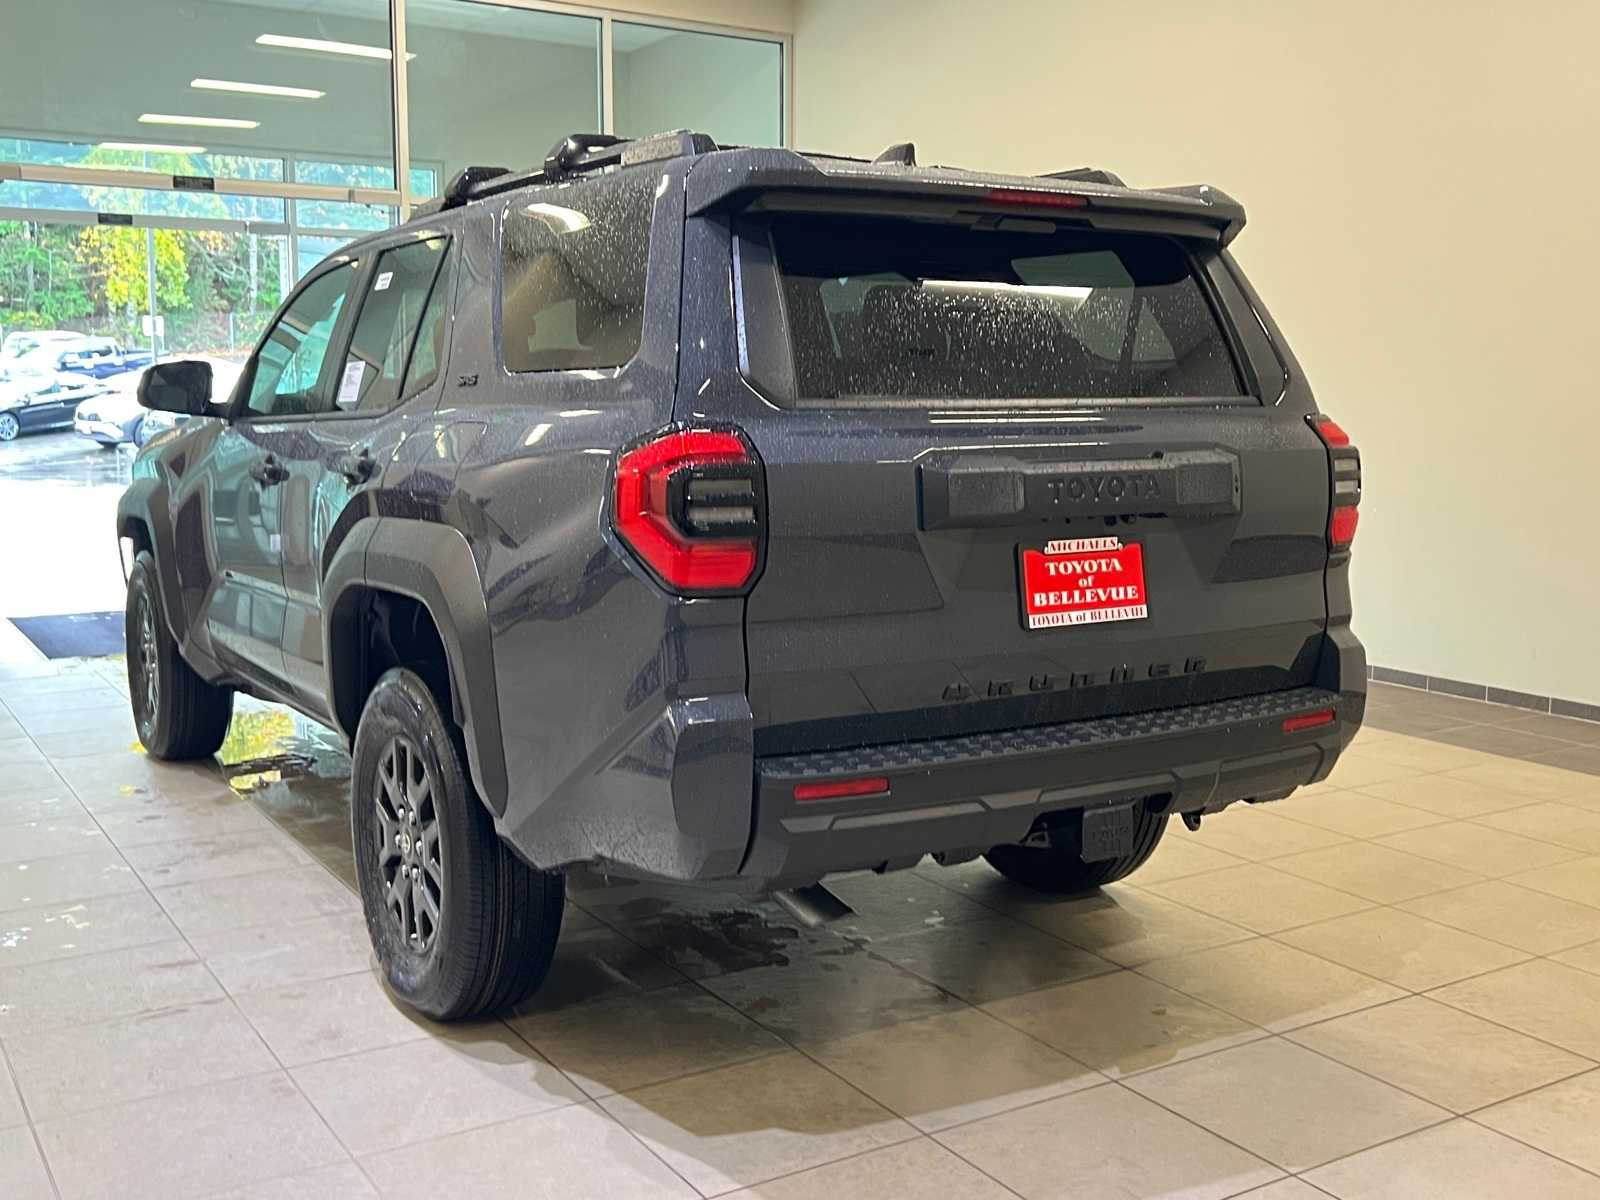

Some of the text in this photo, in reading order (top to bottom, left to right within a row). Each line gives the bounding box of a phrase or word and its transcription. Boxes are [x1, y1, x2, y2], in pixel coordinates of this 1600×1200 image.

[1047, 475, 1161, 501] TOYOTA
[1045, 558, 1123, 576] TOYOTA
[1078, 575, 1095, 587] of
[1033, 586, 1138, 606] BELLEVUE
[1032, 613, 1073, 626] TOYOTA
[1076, 612, 1086, 622] of
